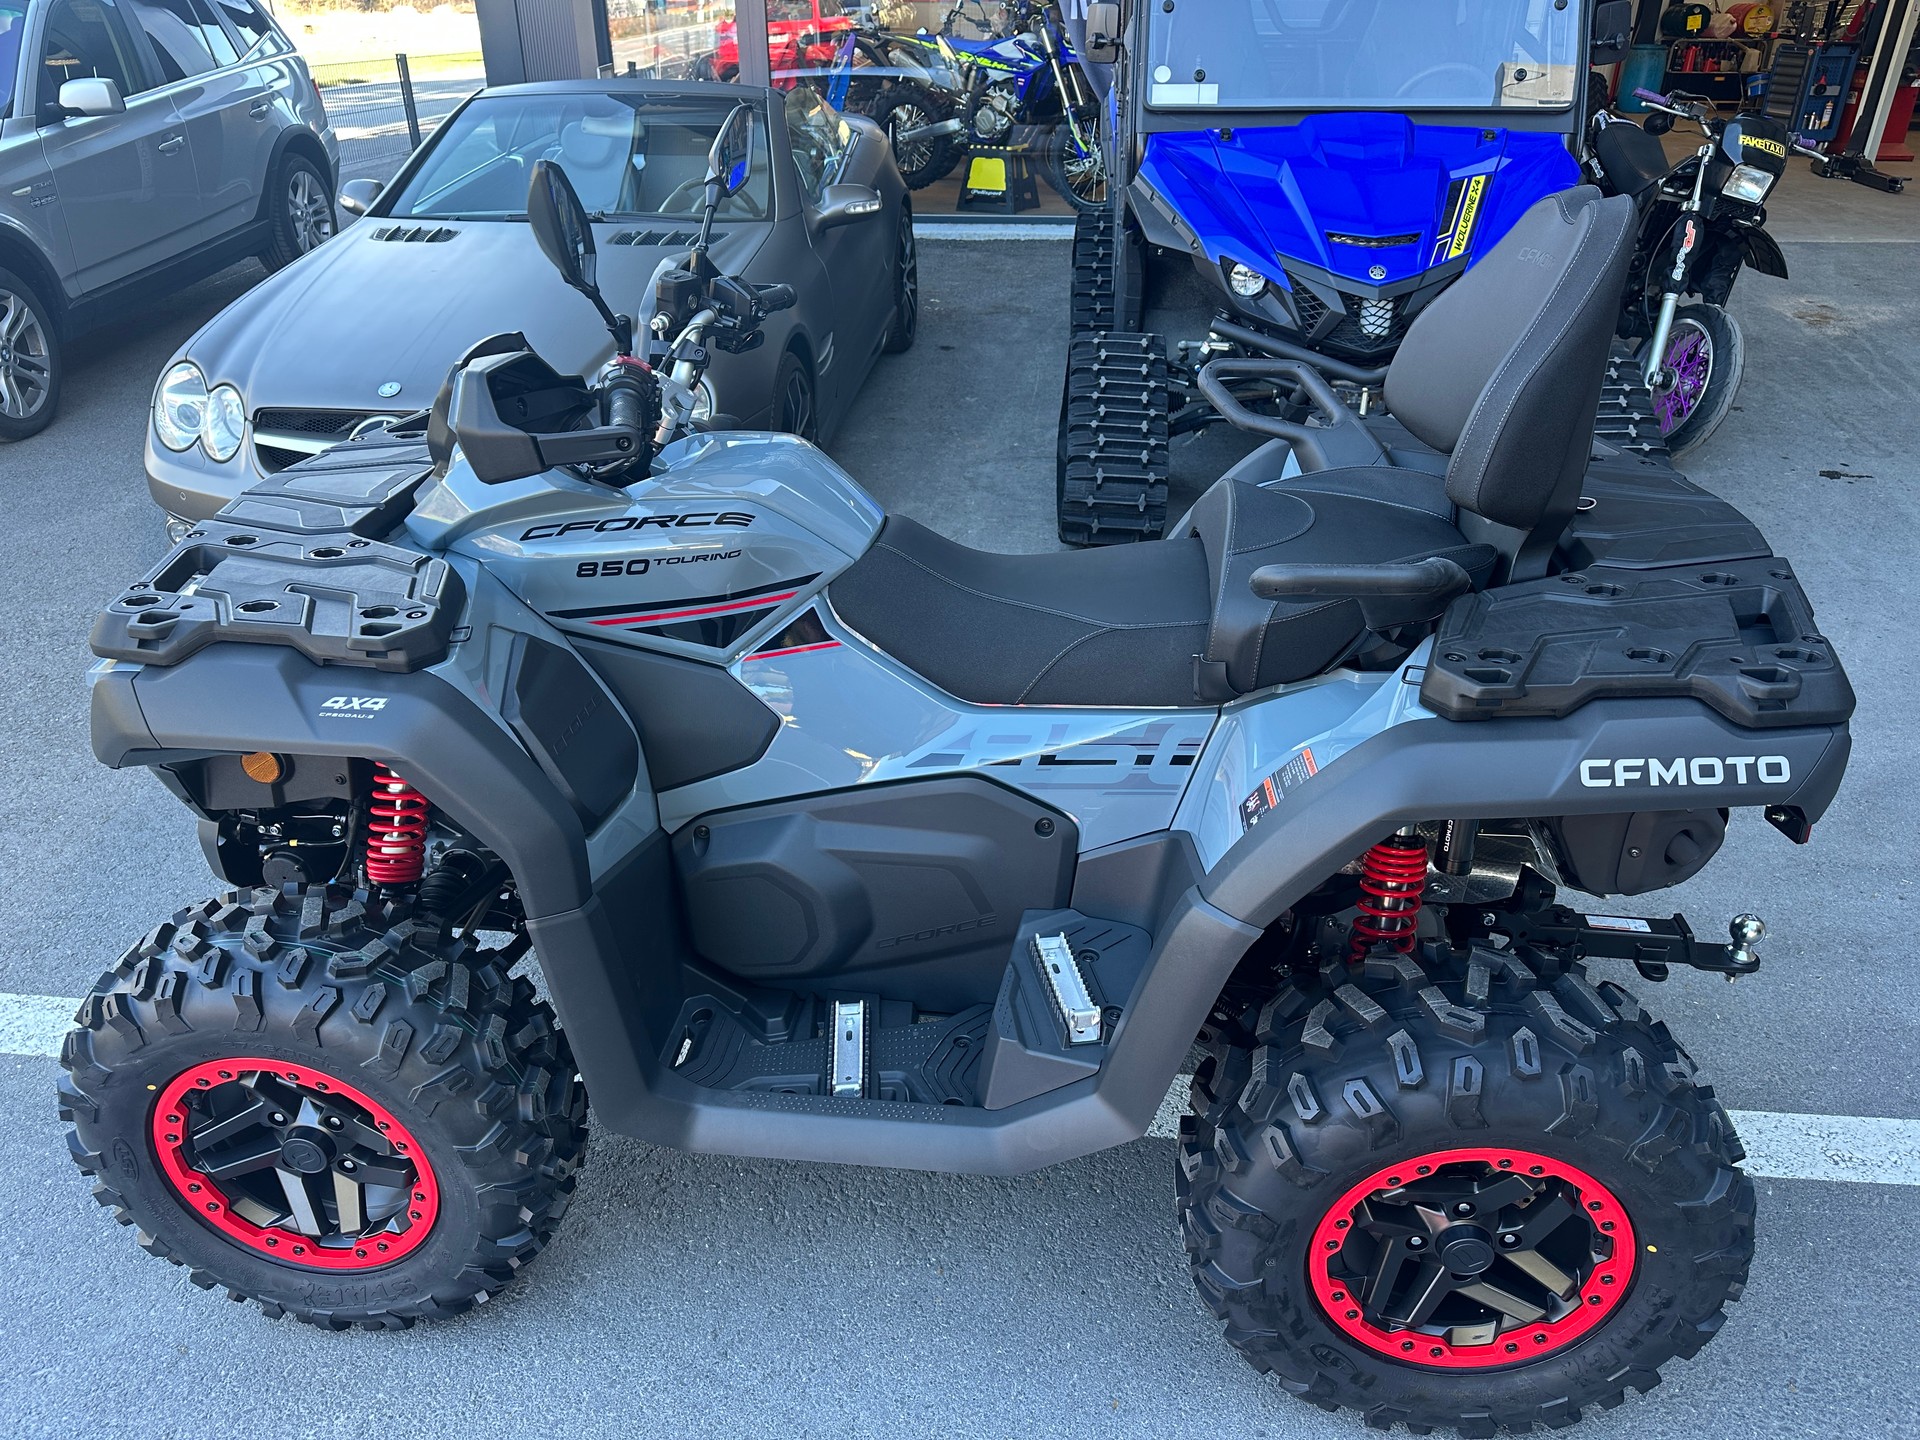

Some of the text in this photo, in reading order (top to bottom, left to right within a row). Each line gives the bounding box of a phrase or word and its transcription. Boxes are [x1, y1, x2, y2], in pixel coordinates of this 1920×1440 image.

[1738, 134, 1784, 156] FAKE TAXI
[1454, 179, 1482, 251] WOLVERINE X4
[519, 511, 756, 542] CFORCE
[575, 549, 742, 578] 850 TOURING
[1579, 755, 1791, 788] CFMOTO
[1443, 819, 1454, 852] CFMOTO
[875, 912, 998, 949] CFORCE
